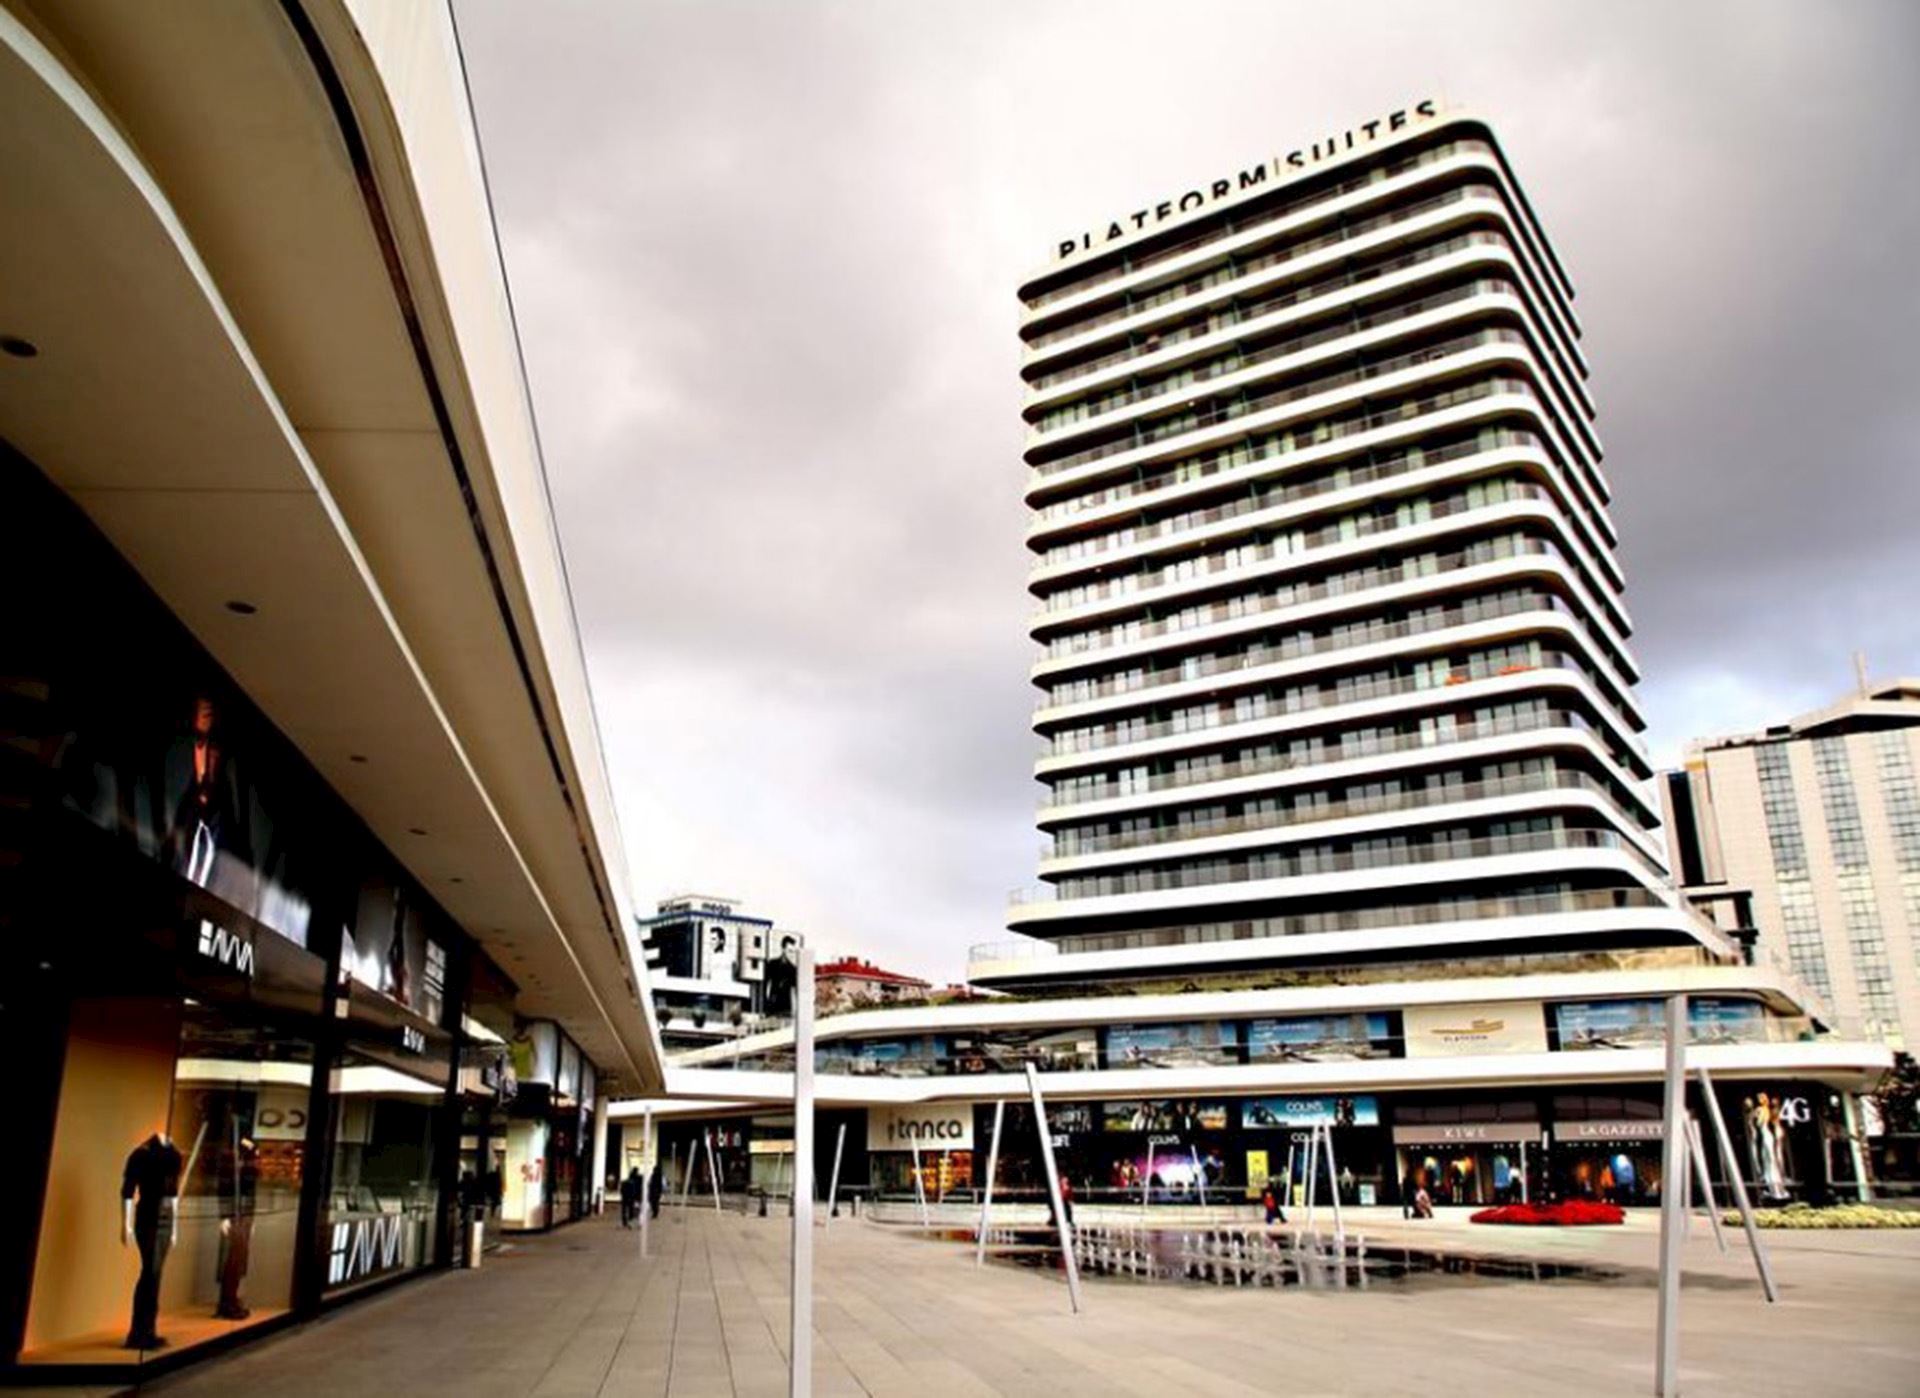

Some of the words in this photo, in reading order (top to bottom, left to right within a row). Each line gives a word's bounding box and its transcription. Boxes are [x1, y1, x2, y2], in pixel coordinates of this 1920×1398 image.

[1059, 165, 1267, 259] PLATFORM
[1286, 100, 1436, 169] SUITES
[1779, 1097, 1811, 1127] 4G
[897, 1117, 963, 1139] tanca
